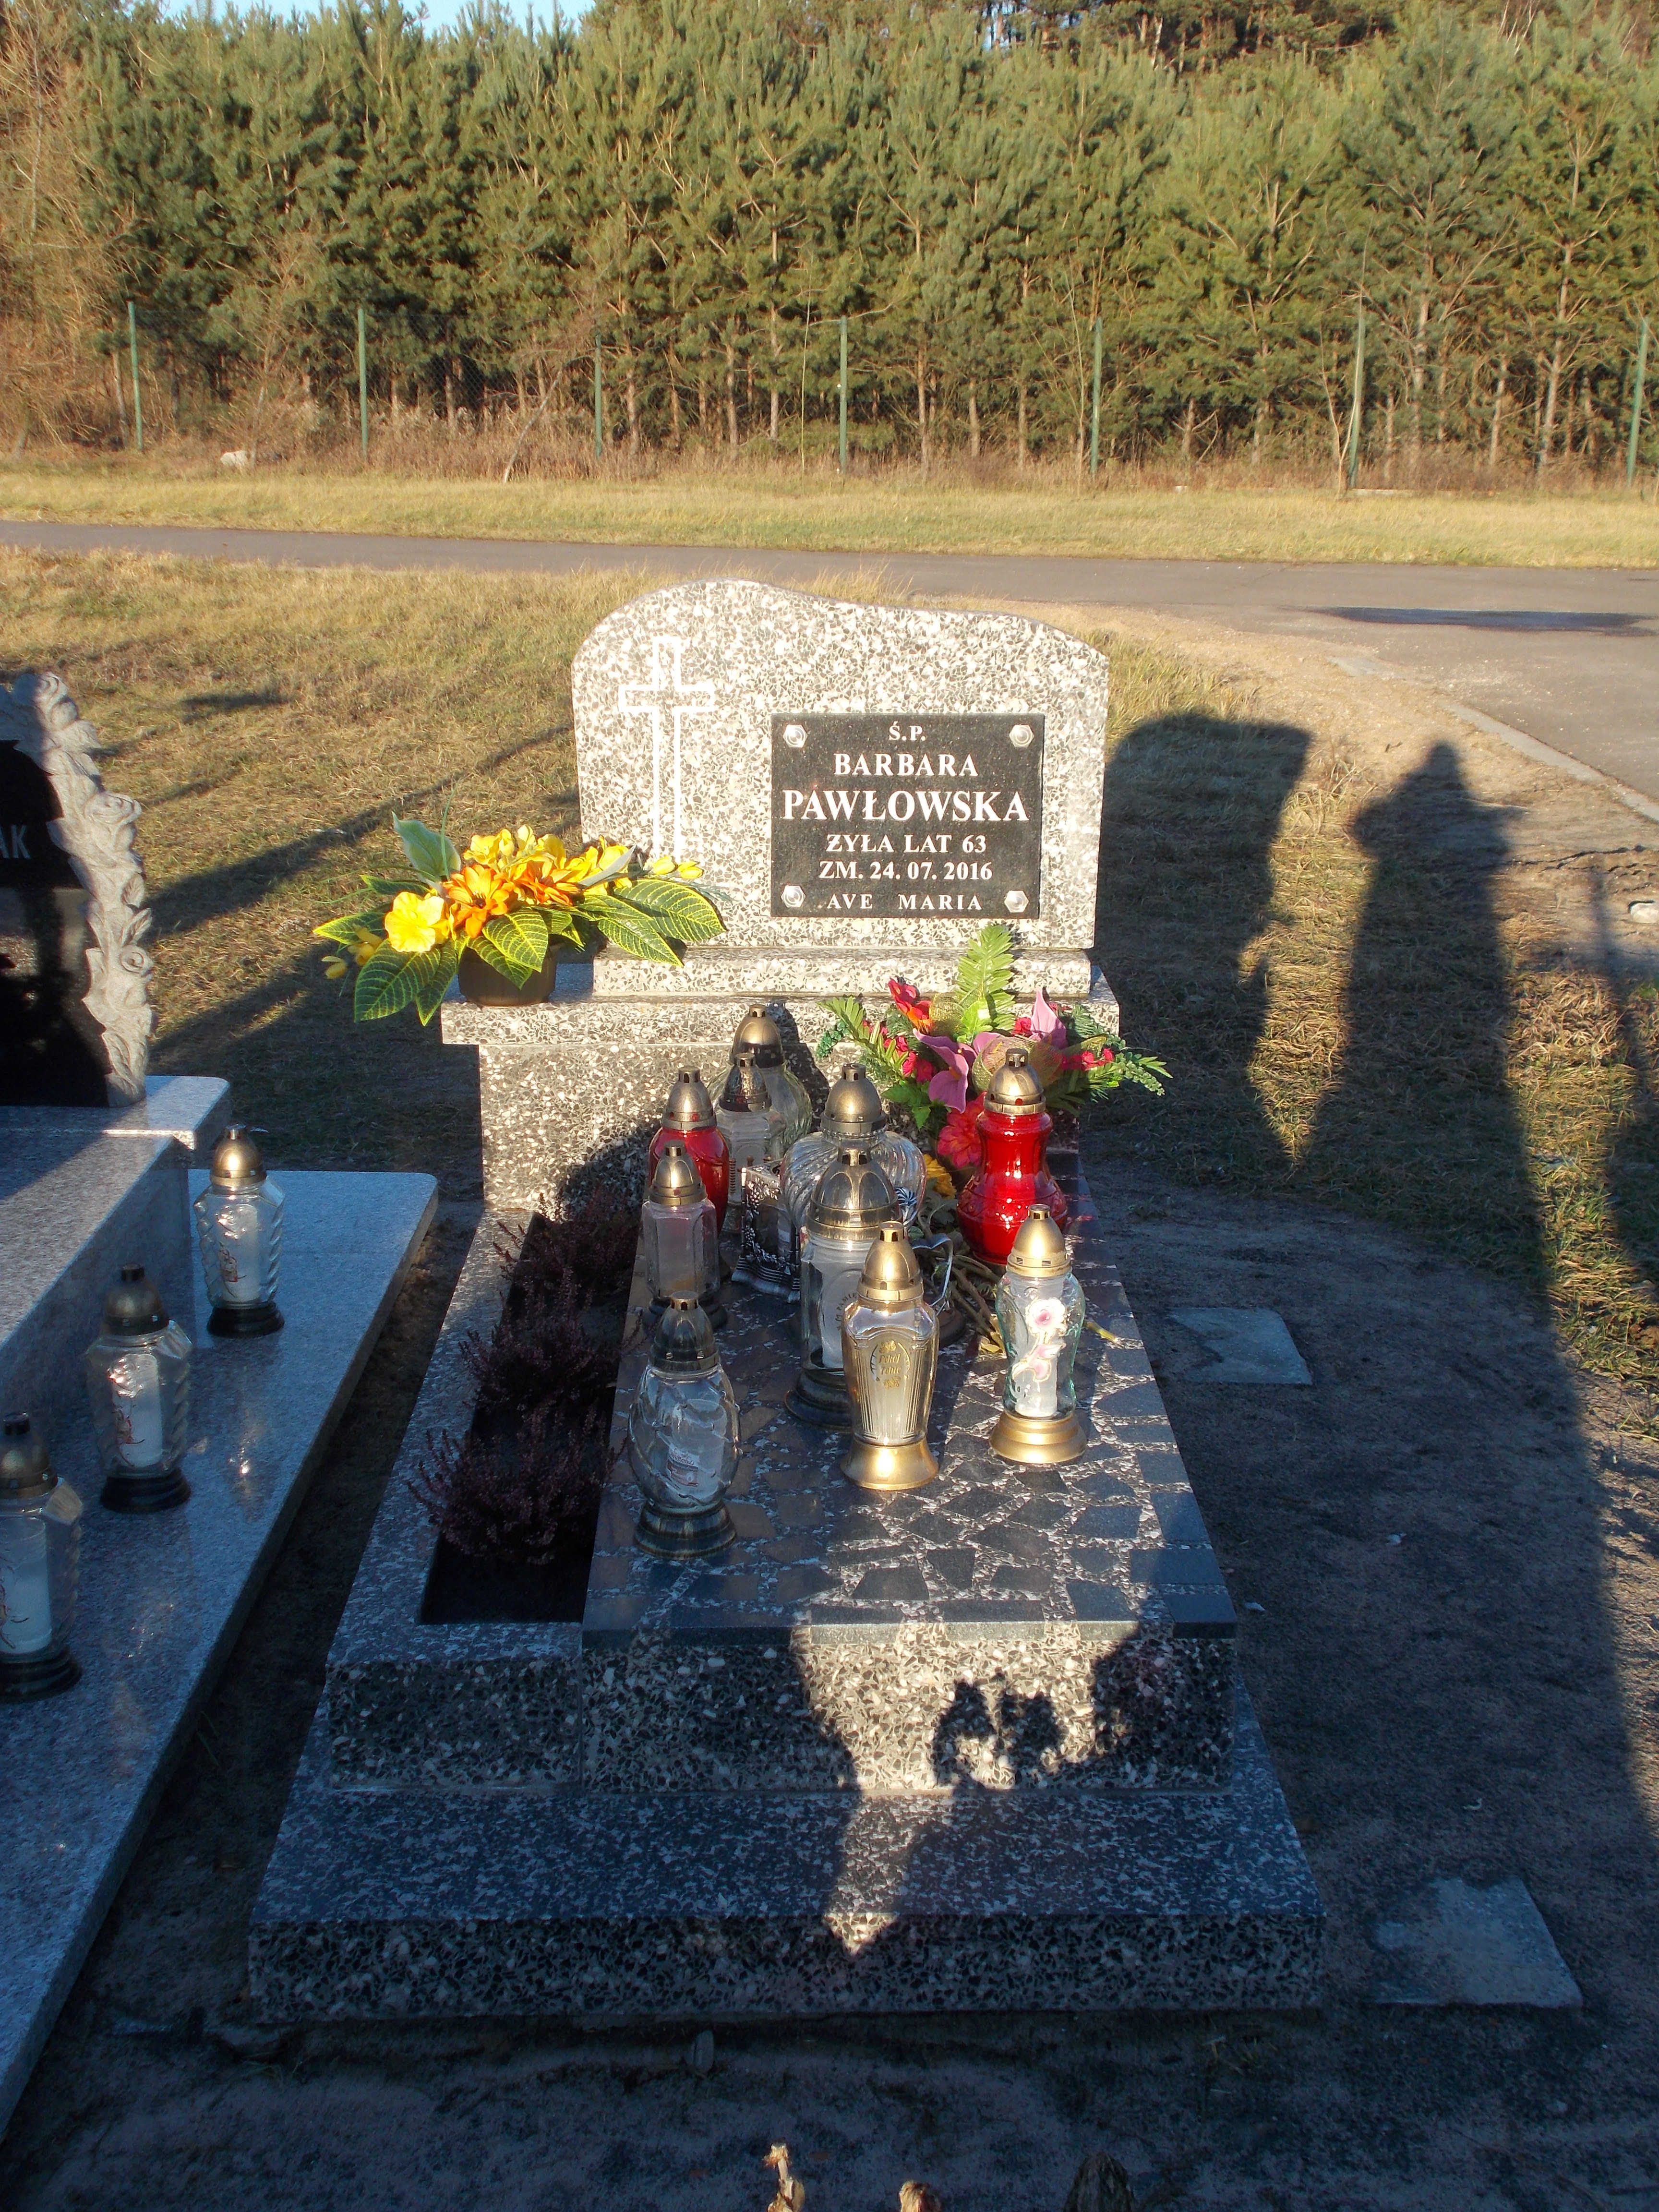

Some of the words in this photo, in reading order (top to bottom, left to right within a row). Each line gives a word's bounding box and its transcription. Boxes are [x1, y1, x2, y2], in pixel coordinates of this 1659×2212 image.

[833, 753, 979, 776] BARBARA
[780, 790, 1030, 821] PAWŁOWSKA
[826, 834, 894, 853] ŻYŁA
[903, 834, 952, 853] LAT
[962, 835, 986, 854] 63
[818, 861, 864, 879] ZM.
[943, 862, 992, 880] 2016
[827, 893, 873, 909] AVE
[898, 894, 982, 911] MARIA
